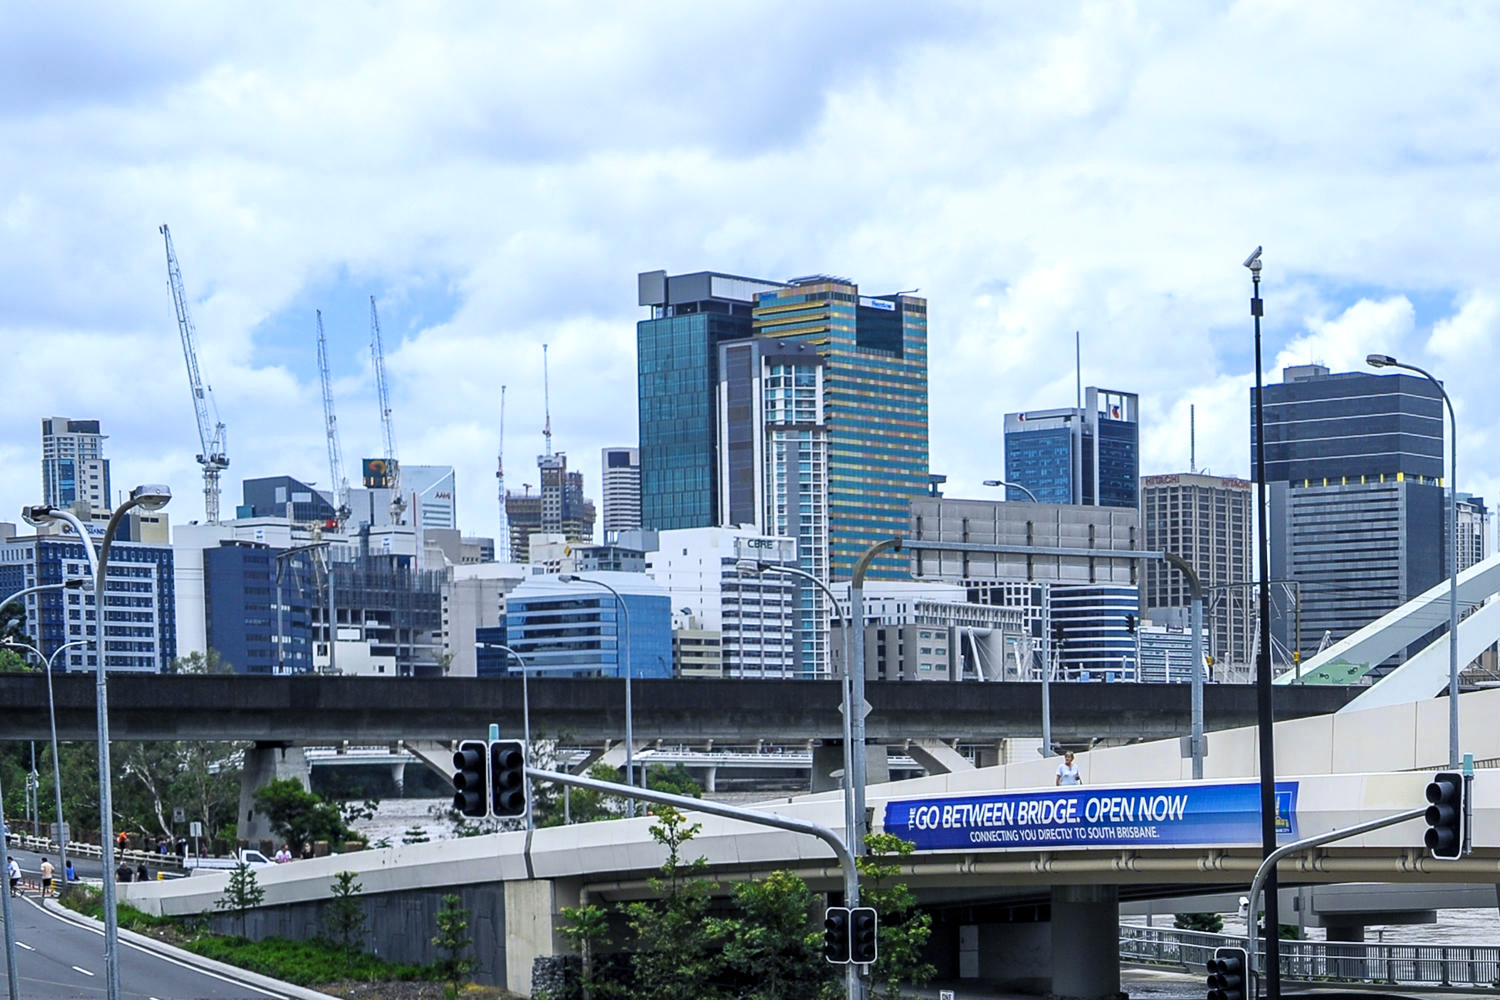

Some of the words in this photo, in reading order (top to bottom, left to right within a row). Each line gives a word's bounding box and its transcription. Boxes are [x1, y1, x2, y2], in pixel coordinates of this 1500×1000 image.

[747, 539, 774, 550] CBRE
[908, 803, 916, 831] THE
[916, 805, 939, 830] GO
[942, 801, 1015, 828] BETWEEN
[1017, 798, 1081, 825] BRIDGE.
[1085, 796, 1135, 823] OPEN
[1138, 794, 1188, 822] NOW
[969, 829, 1019, 843] CONNECTING
[1019, 829, 1037, 841] YOU
[1038, 827, 1073, 840] DIRECTLY
[1073, 827, 1087, 839] TO
[1087, 826, 1116, 839] SOUTH
[1116, 825, 1160, 839] BRISBANE.
